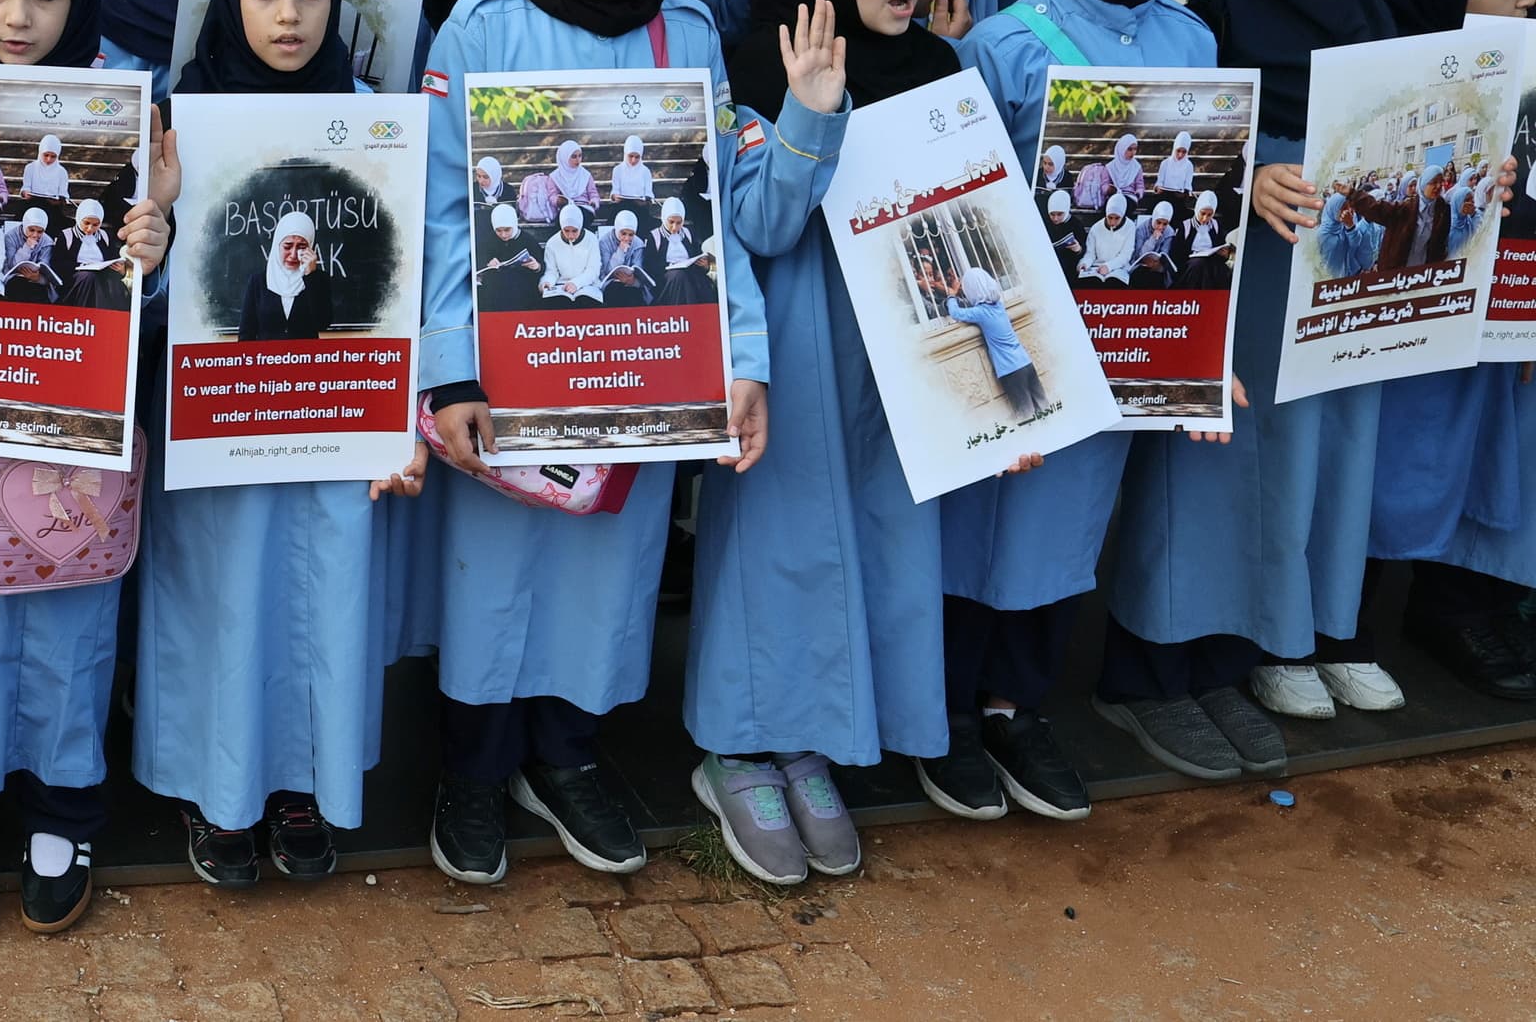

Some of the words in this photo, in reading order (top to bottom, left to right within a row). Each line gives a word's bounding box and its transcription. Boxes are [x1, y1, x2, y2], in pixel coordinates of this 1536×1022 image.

[1367, 268, 1432, 292] الحريات
[1431, 259, 1462, 284] قمع
[1501, 274, 1529, 289] hijab
[1318, 280, 1360, 301] الدينية
[1152, 299, 1200, 315] hicablı
[1379, 300, 1414, 322] شرعة
[1420, 295, 1472, 316] ينتهك
[37, 314, 95, 337] hicablı
[514, 322, 632, 340] Azərbaycanın
[636, 319, 690, 334] hicablı
[1125, 324, 1188, 340] mətanət
[1296, 314, 1338, 342] الإنسان
[1338, 309, 1376, 334] حقوق
[7, 341, 83, 363] mətanət
[181, 356, 191, 369] A
[195, 353, 254, 368] woman's
[256, 352, 311, 365] freedom
[314, 350, 340, 363] and
[343, 350, 365, 363] her
[368, 350, 401, 367] right
[526, 348, 606, 367] qadınları
[611, 345, 681, 363] mətanət
[183, 385, 197, 398] to
[200, 384, 231, 396] wear
[235, 382, 256, 394] the
[259, 380, 292, 396] hijab
[295, 380, 316, 392] are
[319, 377, 397, 395] guaranteed
[569, 373, 645, 391] rəmzidir.
[212, 410, 251, 423] under
[254, 406, 338, 422] international
[341, 405, 364, 419] law
[229, 443, 340, 459] #Alhijab_right_and_choice
